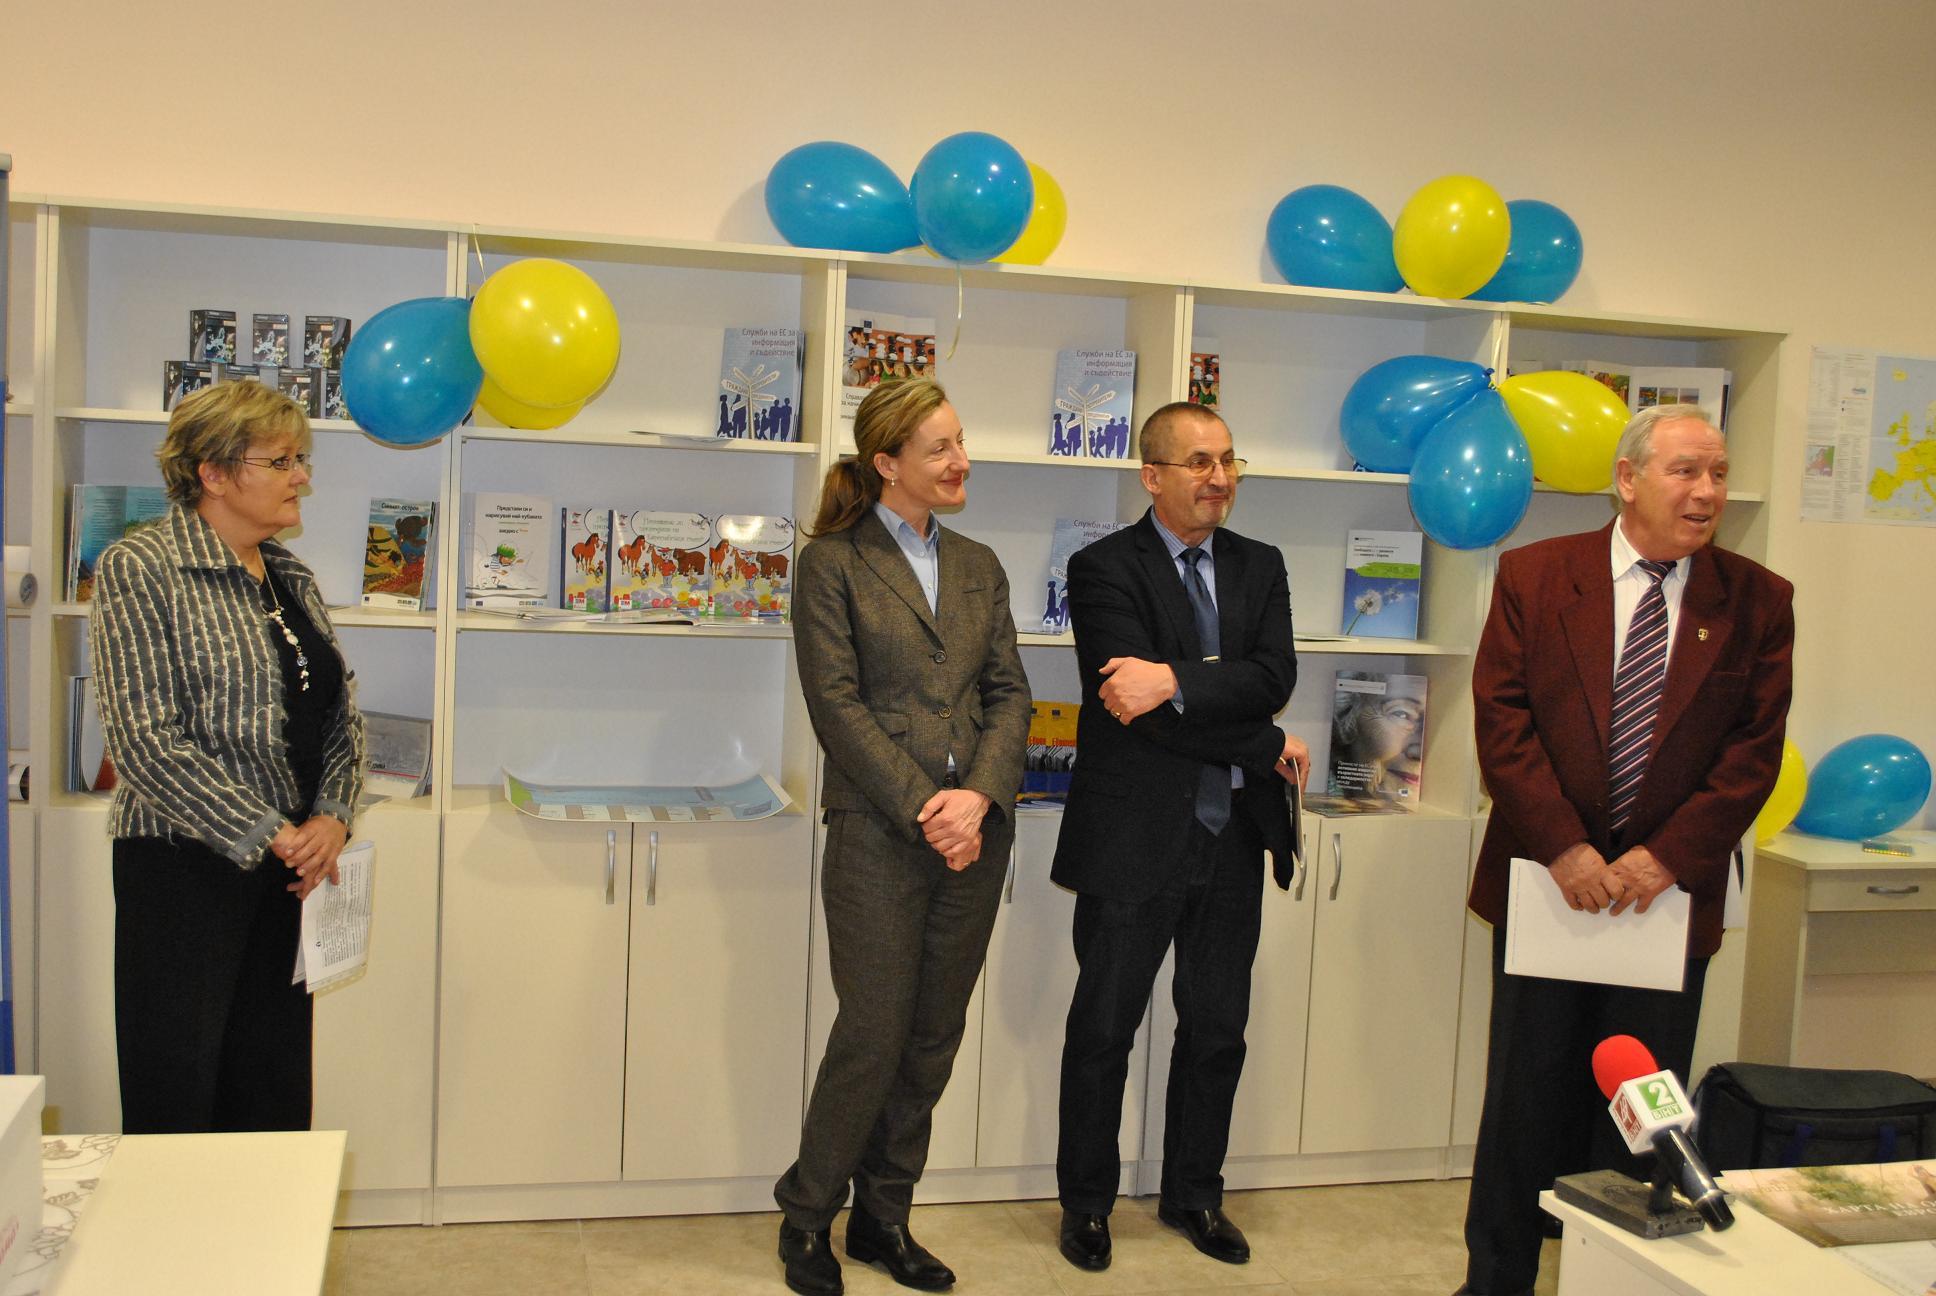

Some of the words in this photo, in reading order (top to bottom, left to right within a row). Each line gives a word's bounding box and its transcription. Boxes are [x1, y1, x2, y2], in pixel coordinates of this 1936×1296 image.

[742, 328, 768, 338] Служби
[779, 328, 787, 337] ЕС
[1076, 350, 1104, 359] Служби
[1115, 350, 1125, 358] ЕС
[1073, 519, 1102, 529] Служби
[1102, 522, 1111, 530] на
[1648, 1082, 1674, 1107] 2
